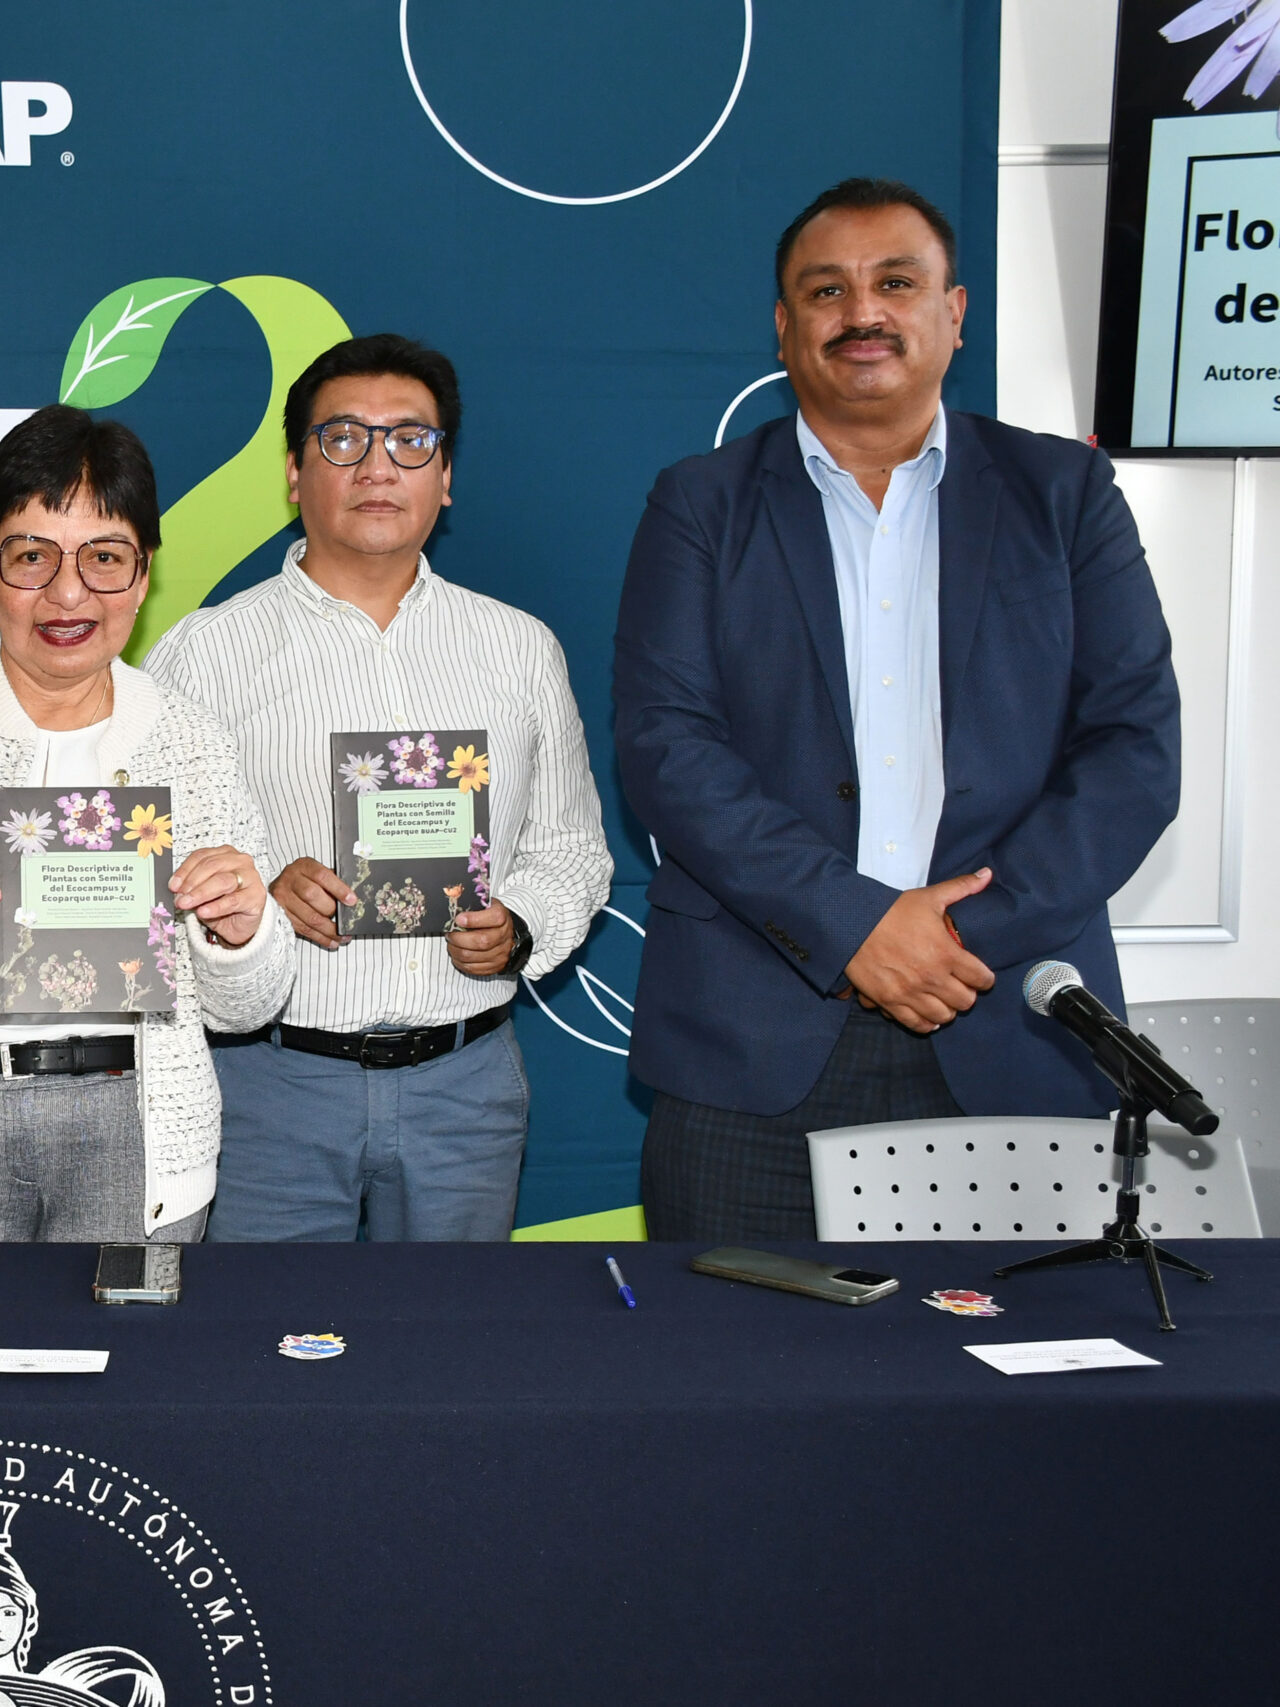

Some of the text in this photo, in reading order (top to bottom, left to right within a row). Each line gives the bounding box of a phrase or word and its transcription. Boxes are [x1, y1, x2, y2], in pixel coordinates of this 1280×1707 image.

[1194, 209, 1280, 252] Flo
[1214, 282, 1280, 324] de
[1204, 364, 1280, 381] Autore
[398, 801, 444, 809] Descriptiva
[41, 864, 134, 873] Flora Descriptiva de
[99, 874, 133, 882] Semilla
[50, 884, 64, 892] del
[67, 884, 119, 893] Ecocampus
[42, 894, 91, 903] Ecoparque
[54, 1467, 244, 1656] AUTÓNOMA
